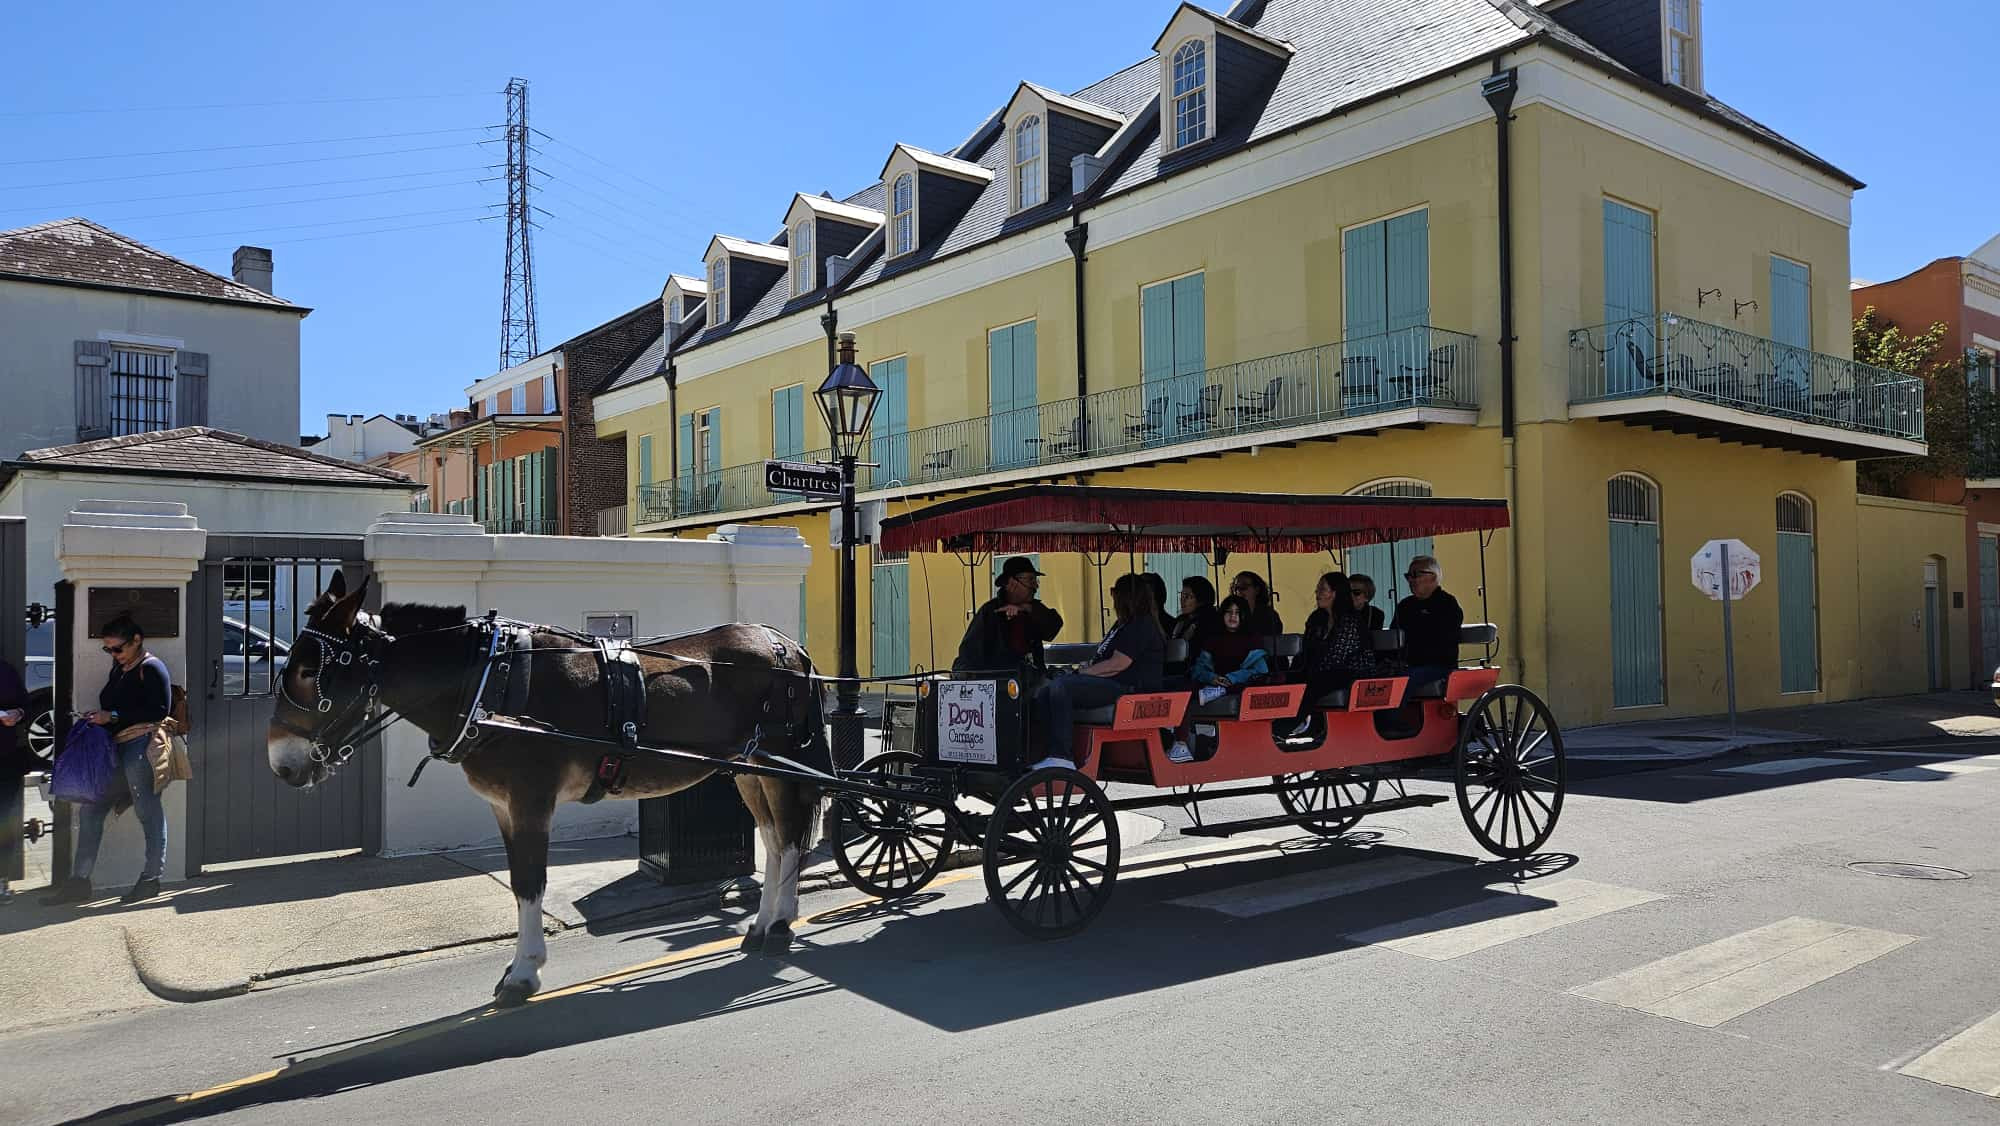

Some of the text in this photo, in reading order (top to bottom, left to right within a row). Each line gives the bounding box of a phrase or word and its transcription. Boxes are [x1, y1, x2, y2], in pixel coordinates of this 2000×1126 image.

[769, 470, 837, 489] Chartres
[948, 701, 984, 731] Royal
[948, 728, 984, 748] Carriages
